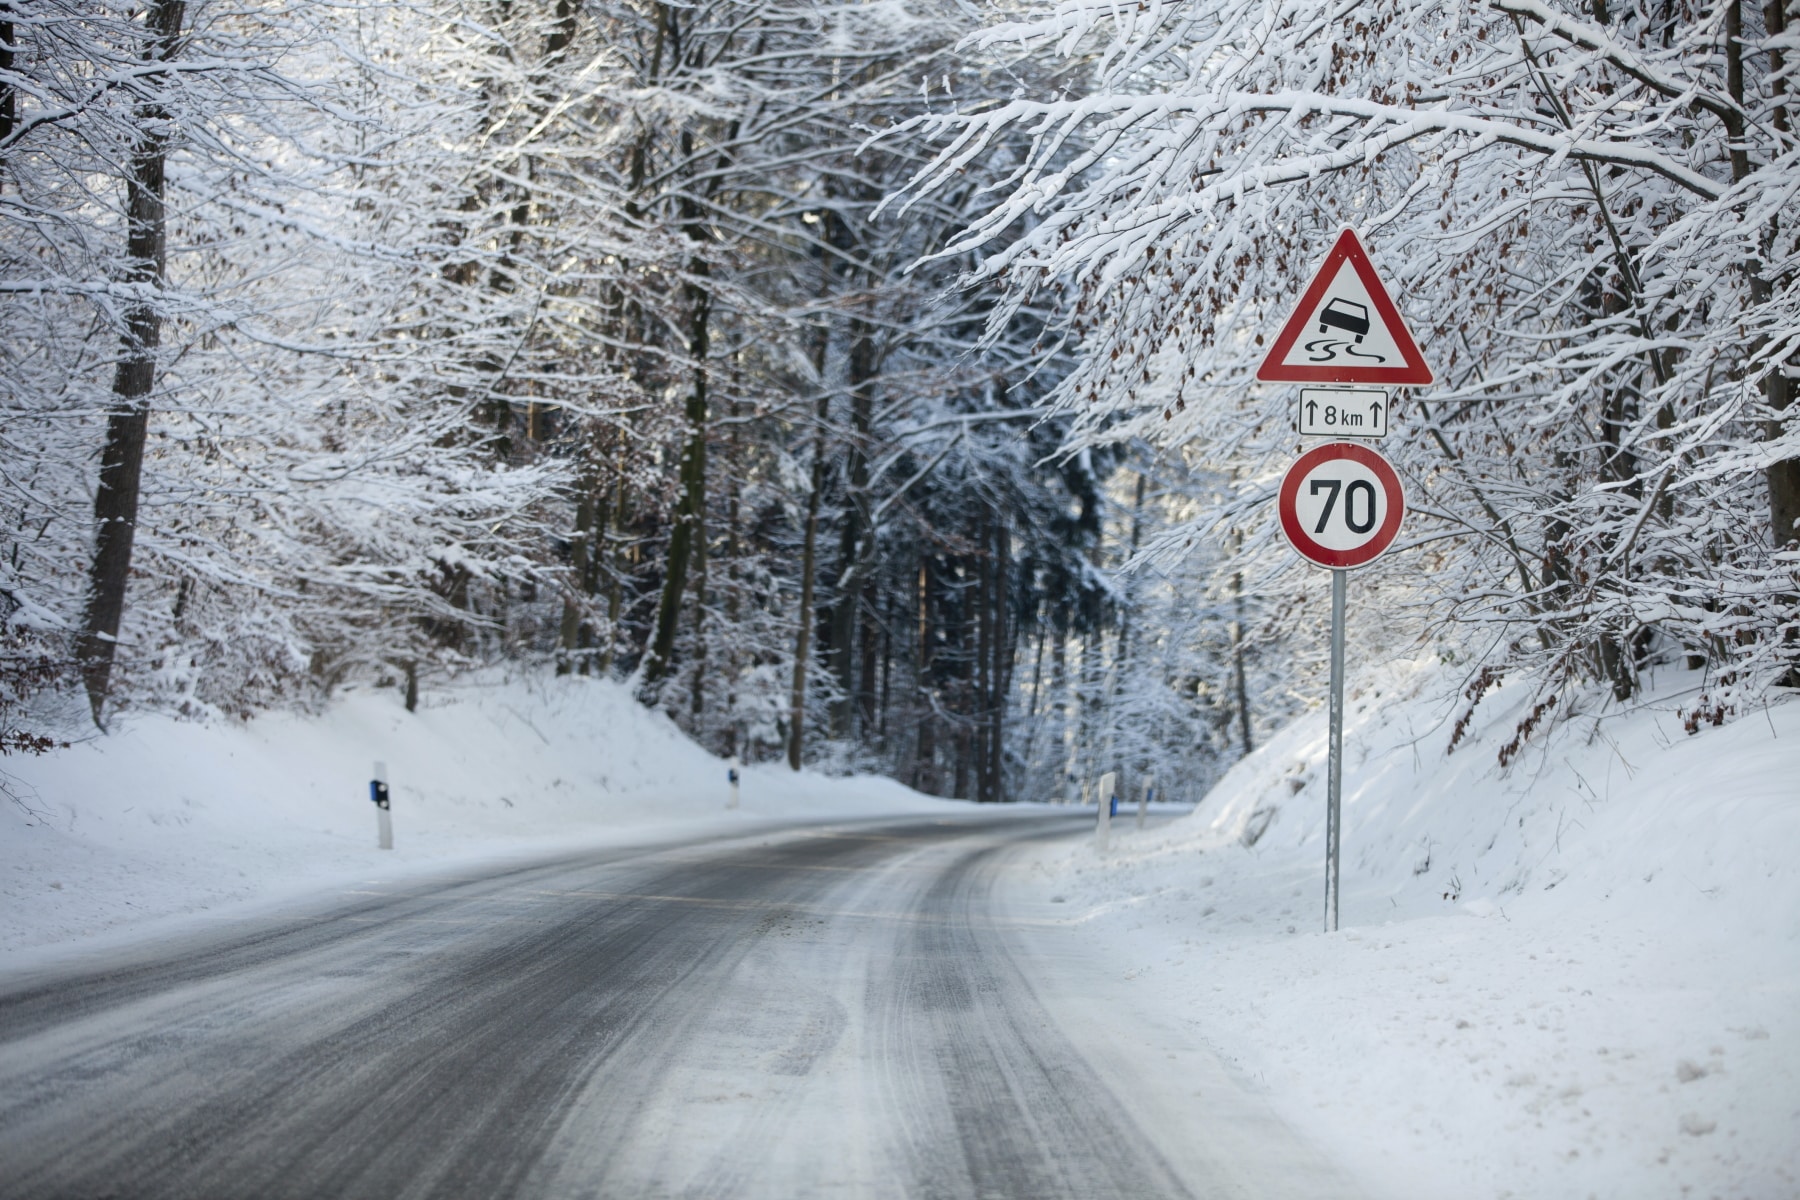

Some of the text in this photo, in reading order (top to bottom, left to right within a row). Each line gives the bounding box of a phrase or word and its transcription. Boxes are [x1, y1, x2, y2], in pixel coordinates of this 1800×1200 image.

[1324, 405, 1363, 426] 8 km
[1310, 479, 1376, 534] 70
